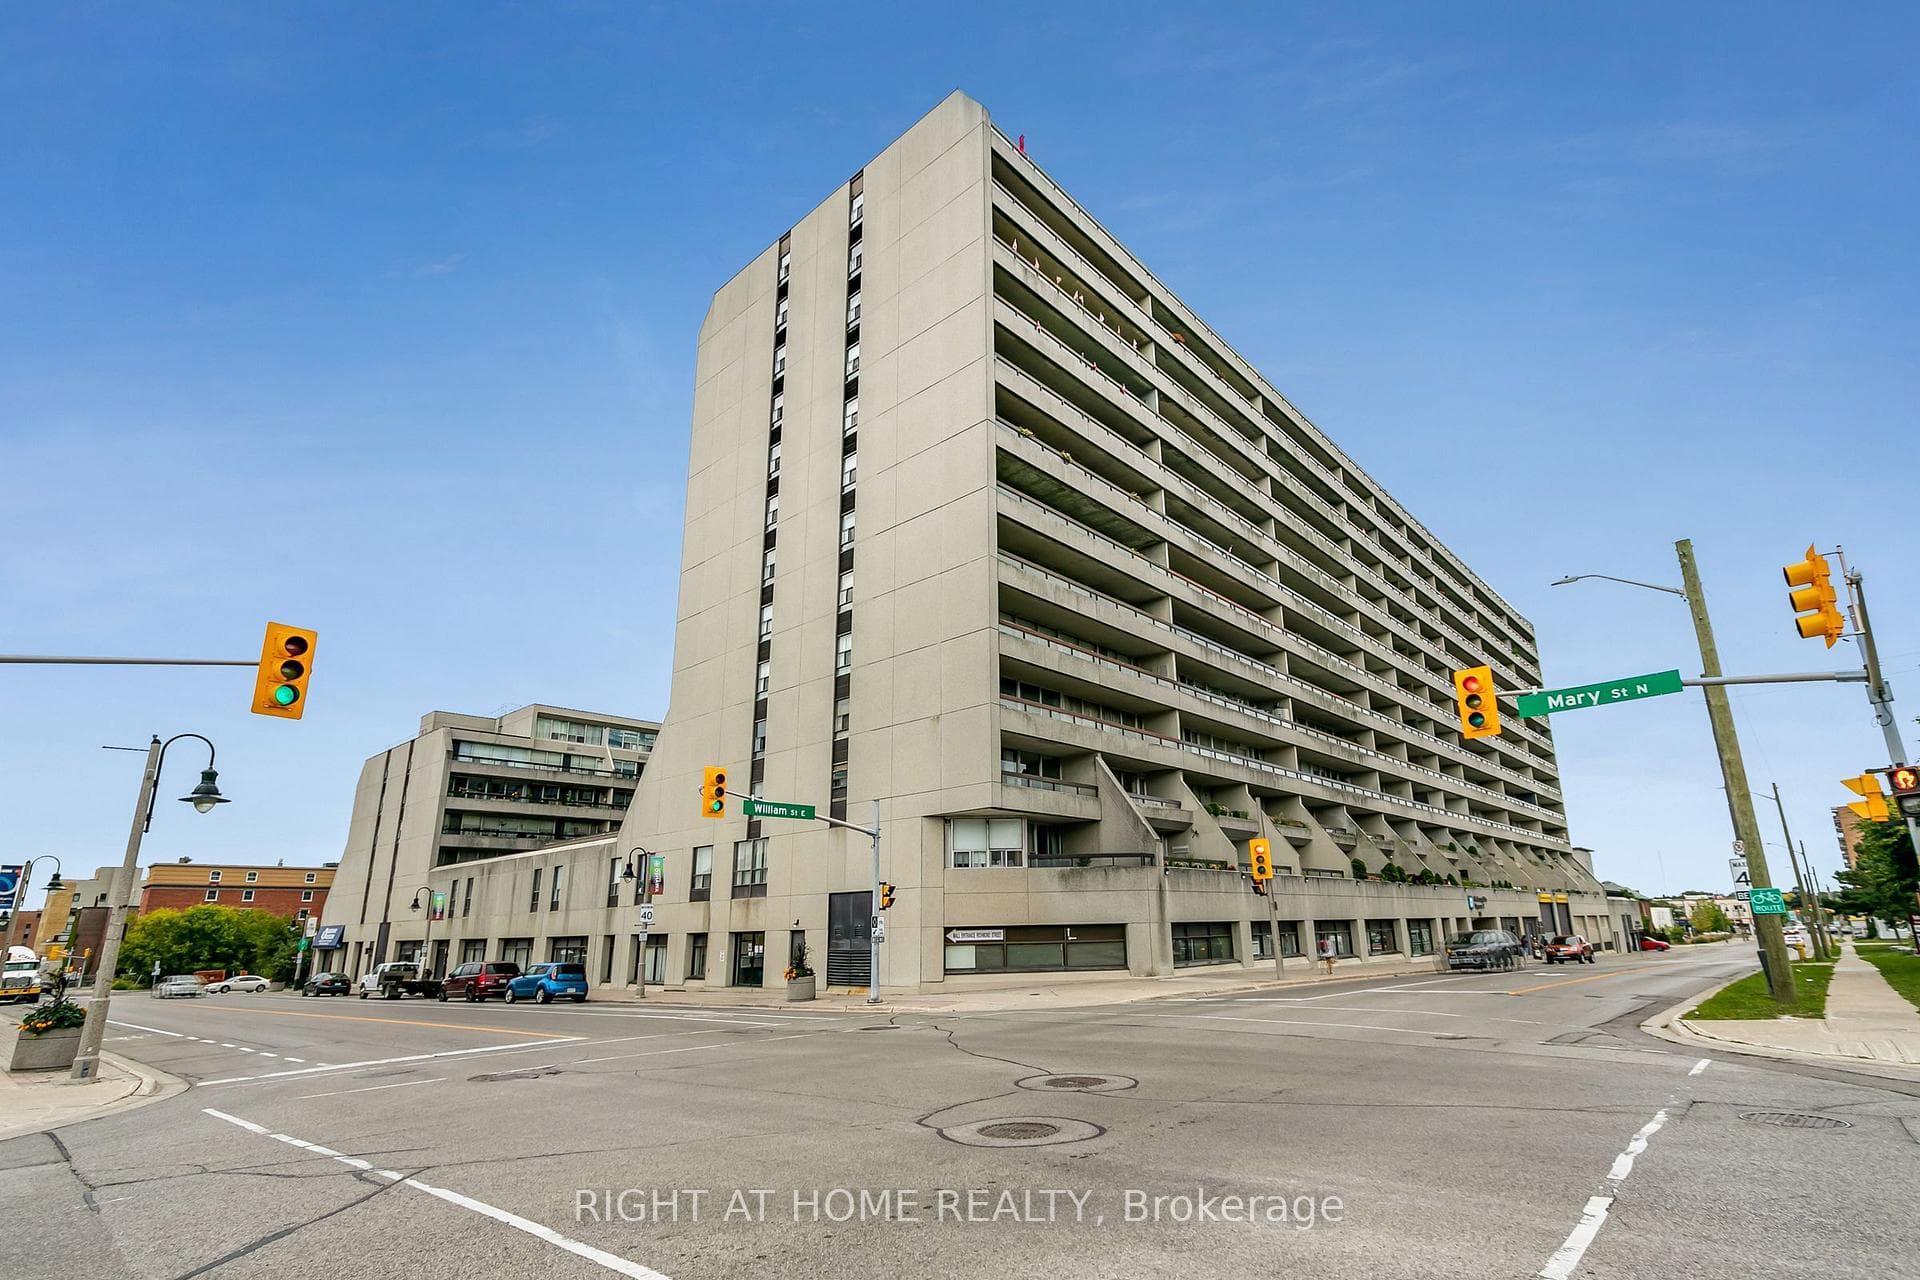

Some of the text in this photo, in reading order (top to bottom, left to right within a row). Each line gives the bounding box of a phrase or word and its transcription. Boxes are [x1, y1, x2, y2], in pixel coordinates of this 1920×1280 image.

[1547, 683, 1648, 709] Mary St N
[754, 803, 787, 816] William
[1735, 871, 1752, 886] 4
[641, 911, 653, 920] 40
